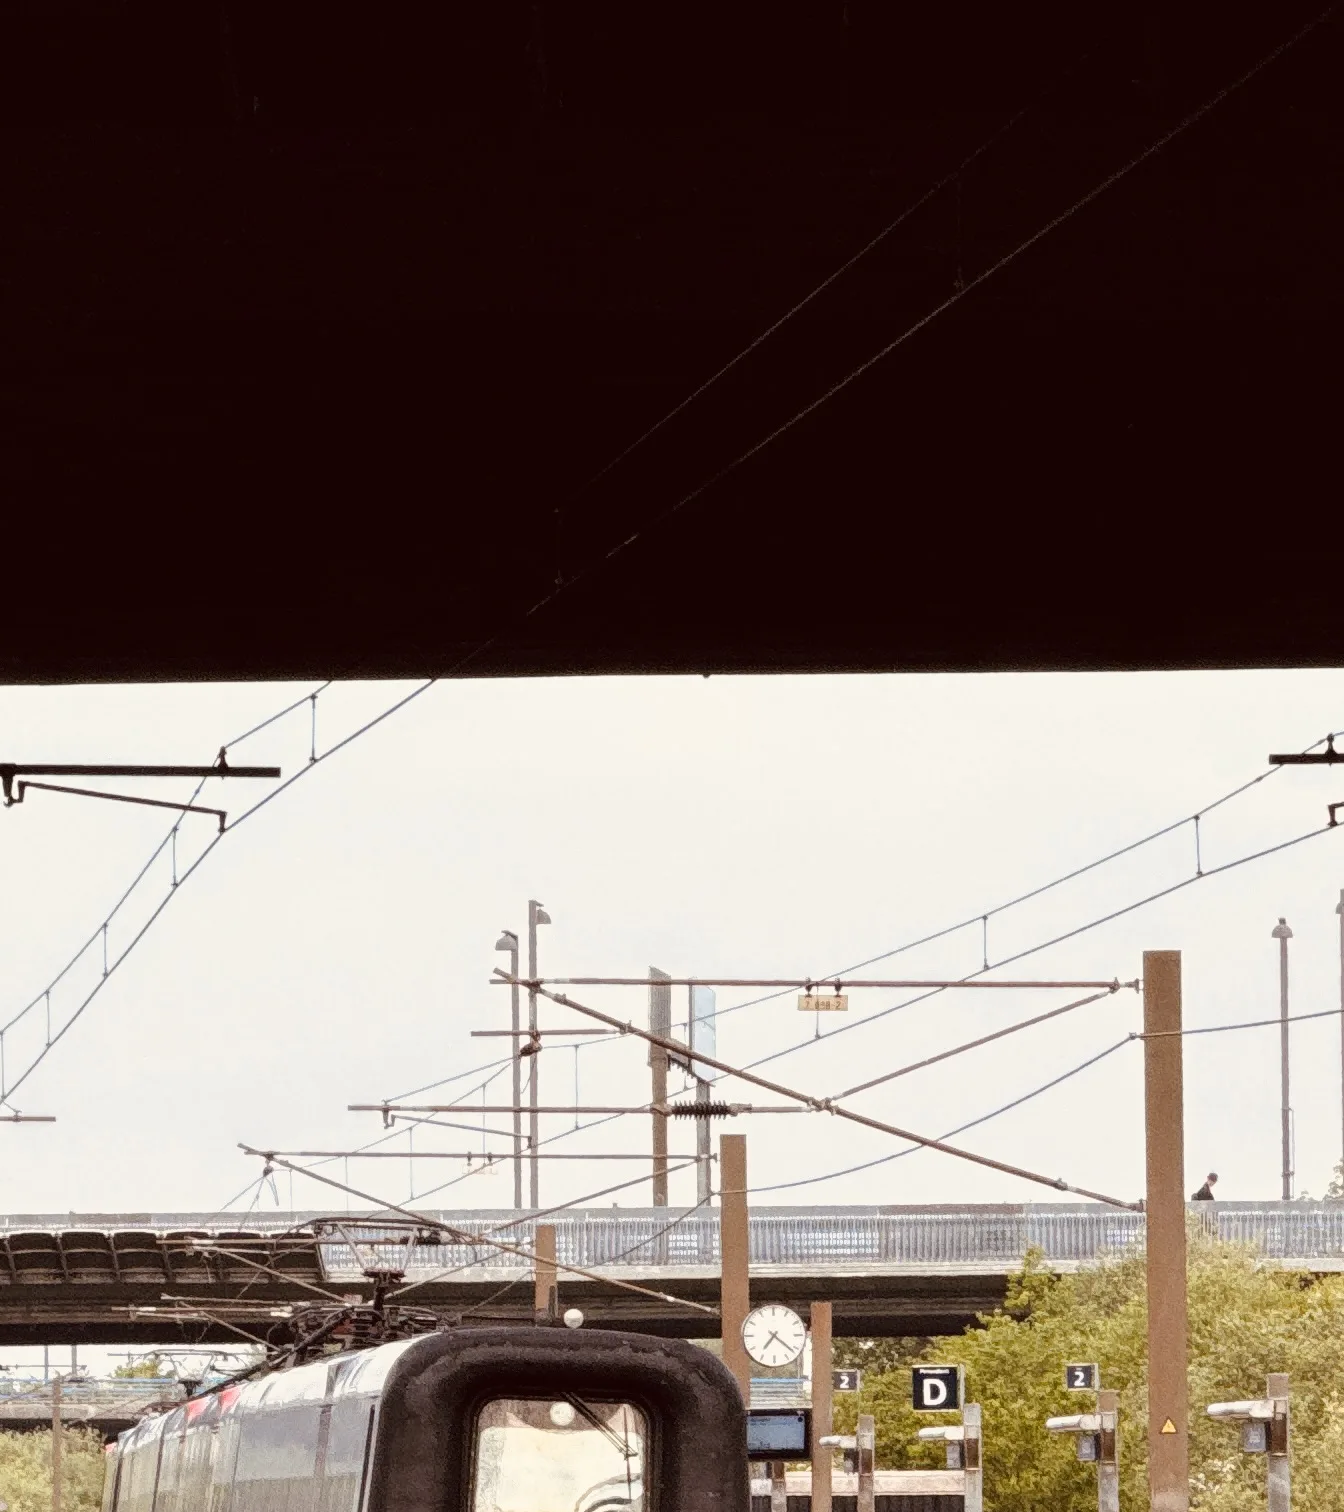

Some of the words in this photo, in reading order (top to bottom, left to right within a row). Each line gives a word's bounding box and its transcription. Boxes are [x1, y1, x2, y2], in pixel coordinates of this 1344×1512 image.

[839, 1375, 850, 1389] 2
[1073, 1371, 1086, 1387] 2
[922, 1378, 947, 1406] D
